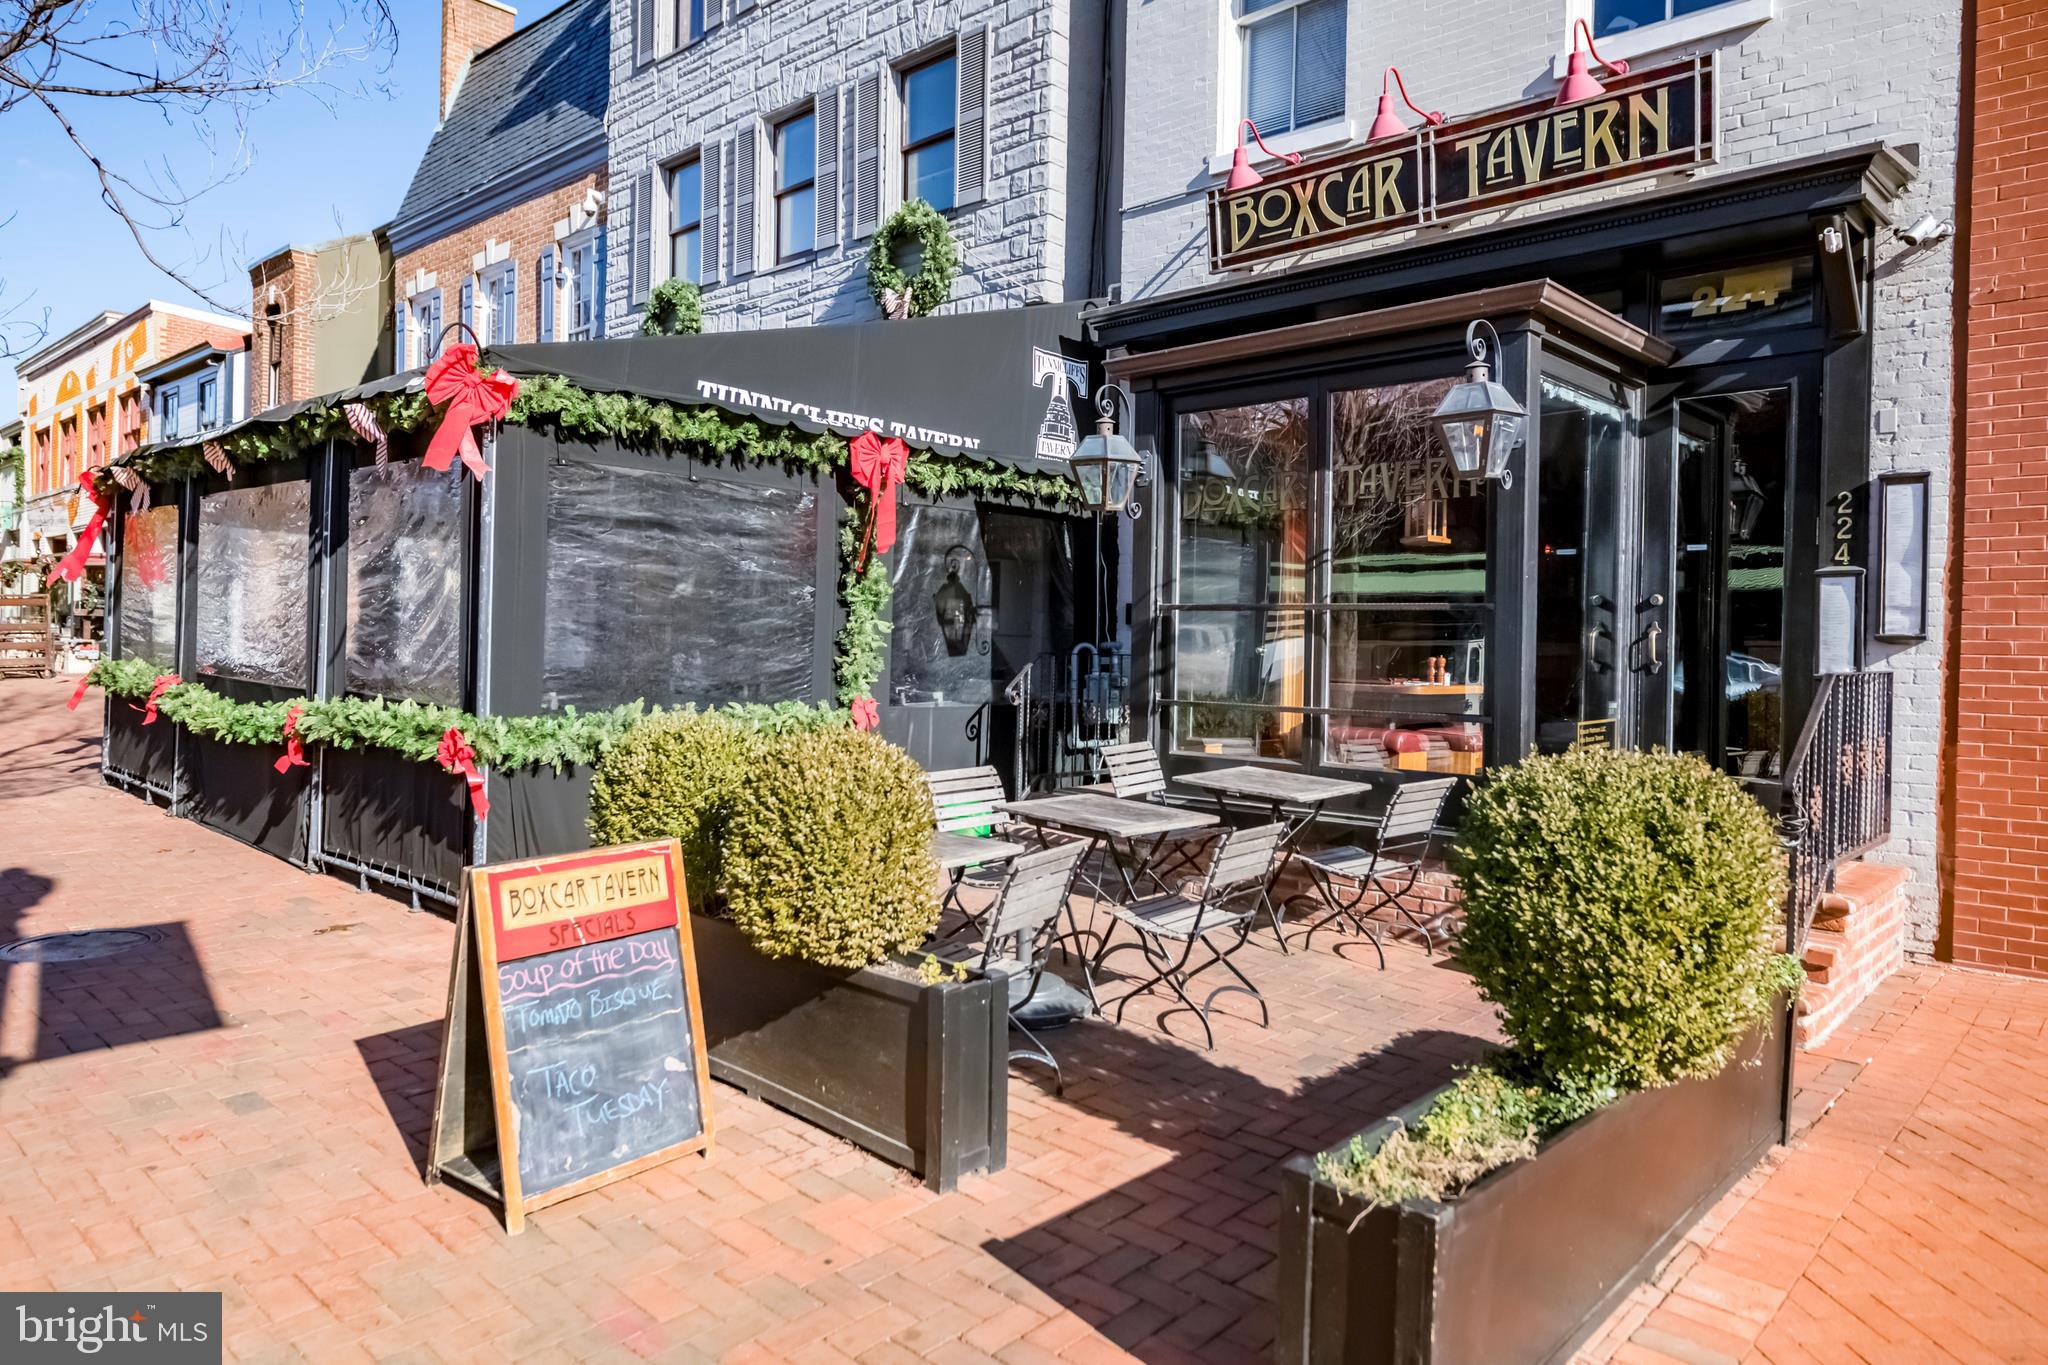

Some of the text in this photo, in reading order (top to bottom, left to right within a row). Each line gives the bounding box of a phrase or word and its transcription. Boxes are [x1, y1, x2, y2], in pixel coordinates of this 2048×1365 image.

[1230, 87, 1669, 253] BOXCAR TAVERN
[1692, 277, 1779, 317] 224
[1040, 440, 1072, 456] TAVERN
[1834, 491, 1853, 566] 224
[509, 866, 661, 919] BOXCAR TAVERN
[549, 911, 637, 946] SPECIALS
[499, 937, 678, 996] Soup of the Day
[527, 1060, 597, 1099] TACO
[563, 1078, 668, 1138] TUESDAY
